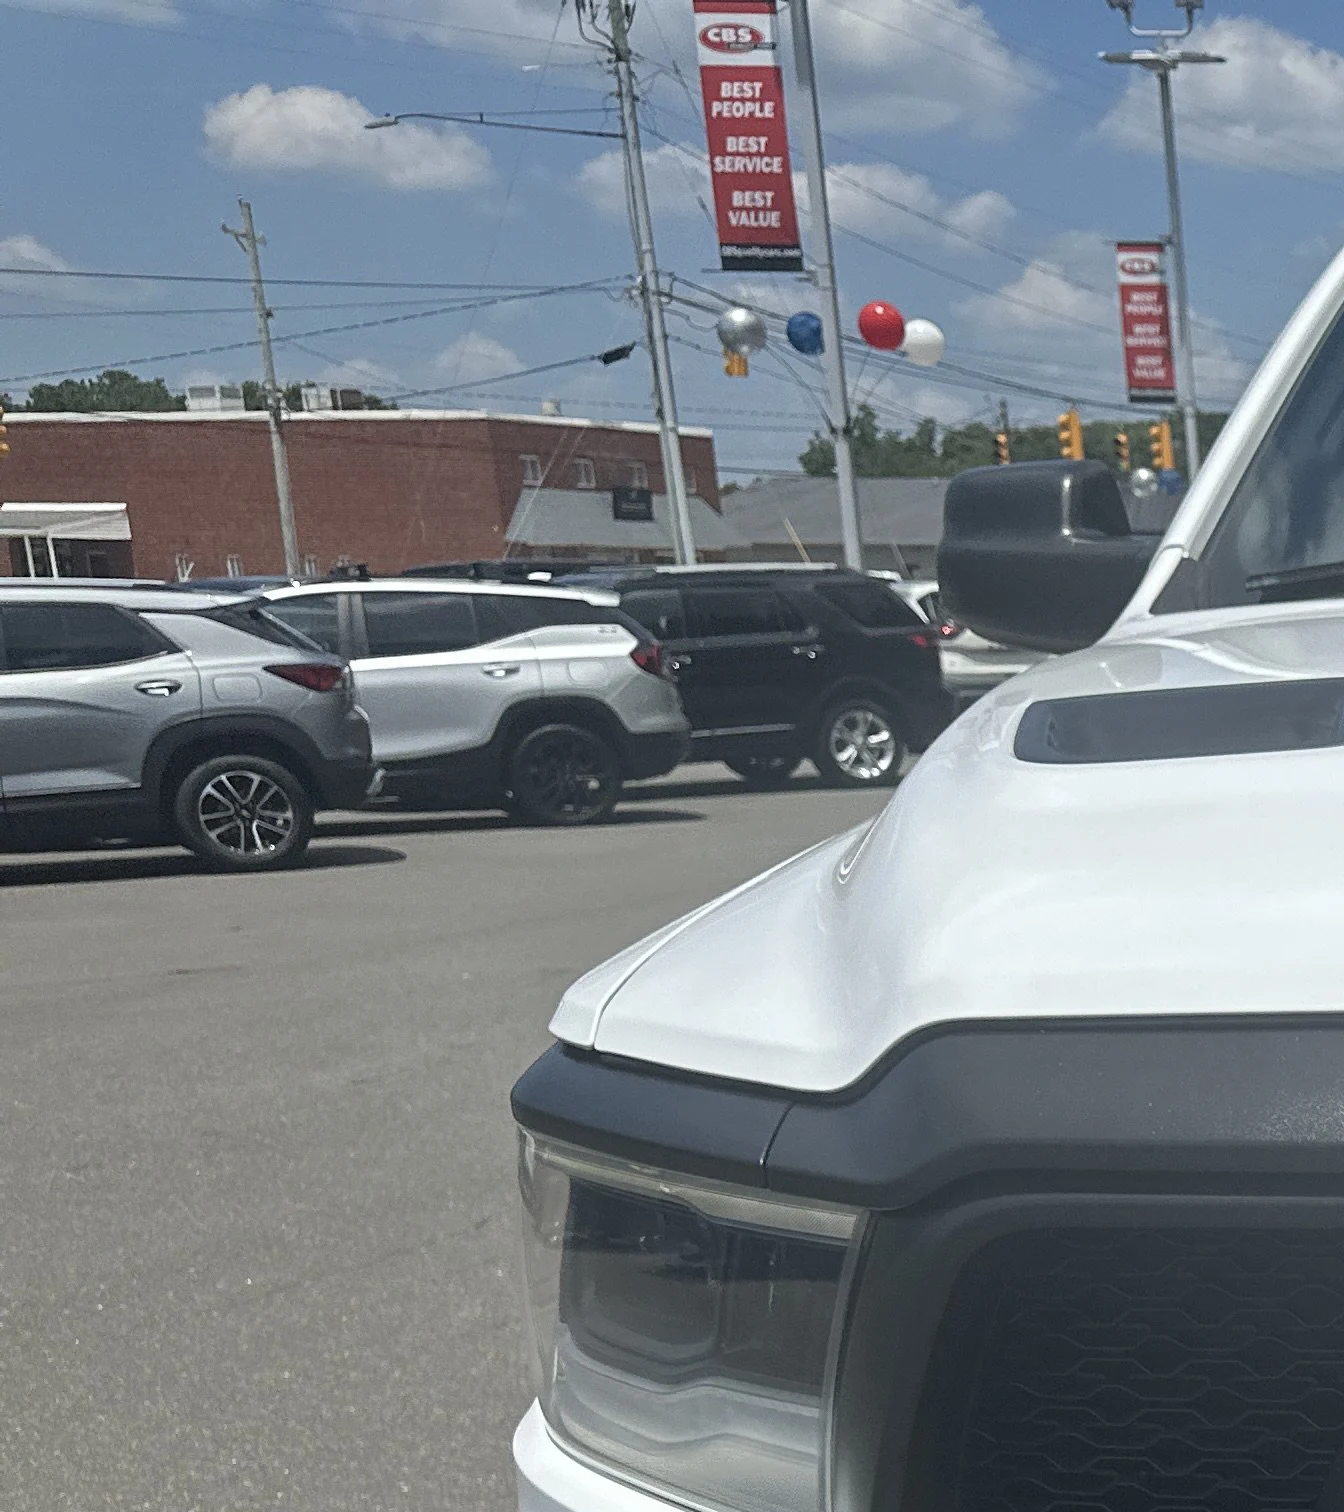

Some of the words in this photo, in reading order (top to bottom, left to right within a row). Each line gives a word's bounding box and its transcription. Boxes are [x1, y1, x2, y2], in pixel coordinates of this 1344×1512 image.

[707, 27, 753, 42] CBS
[720, 81, 763, 98] BEST
[711, 101, 776, 119] PEOPLE
[726, 136, 769, 153] BEST
[713, 156, 784, 174] SERVICE
[732, 190, 775, 208] BEST
[727, 210, 782, 228] VALUE
